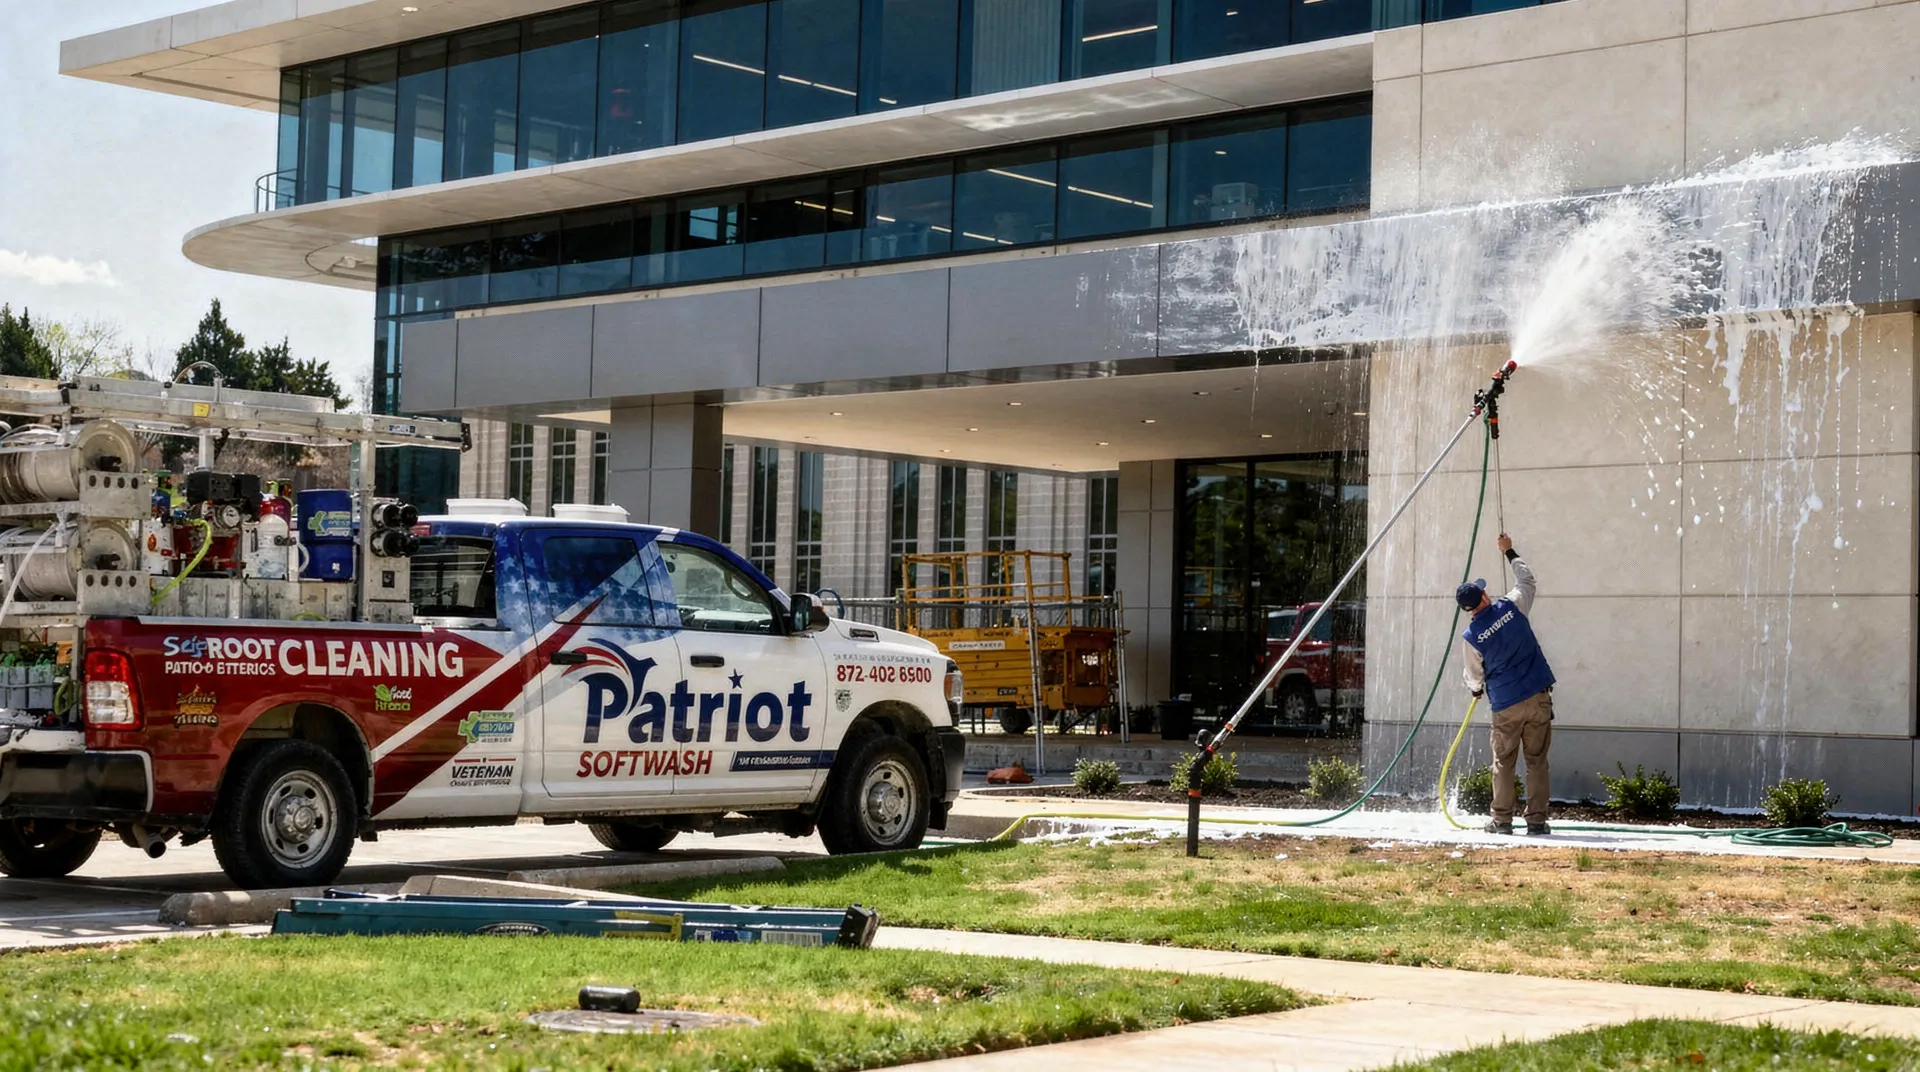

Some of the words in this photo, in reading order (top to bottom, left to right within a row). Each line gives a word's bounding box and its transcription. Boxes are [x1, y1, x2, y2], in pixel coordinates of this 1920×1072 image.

[205, 637, 276, 660] ROOT
[278, 638, 464, 678] CLEANING
[578, 669, 812, 744] Patriot
[576, 750, 713, 778] SOFTWASH
